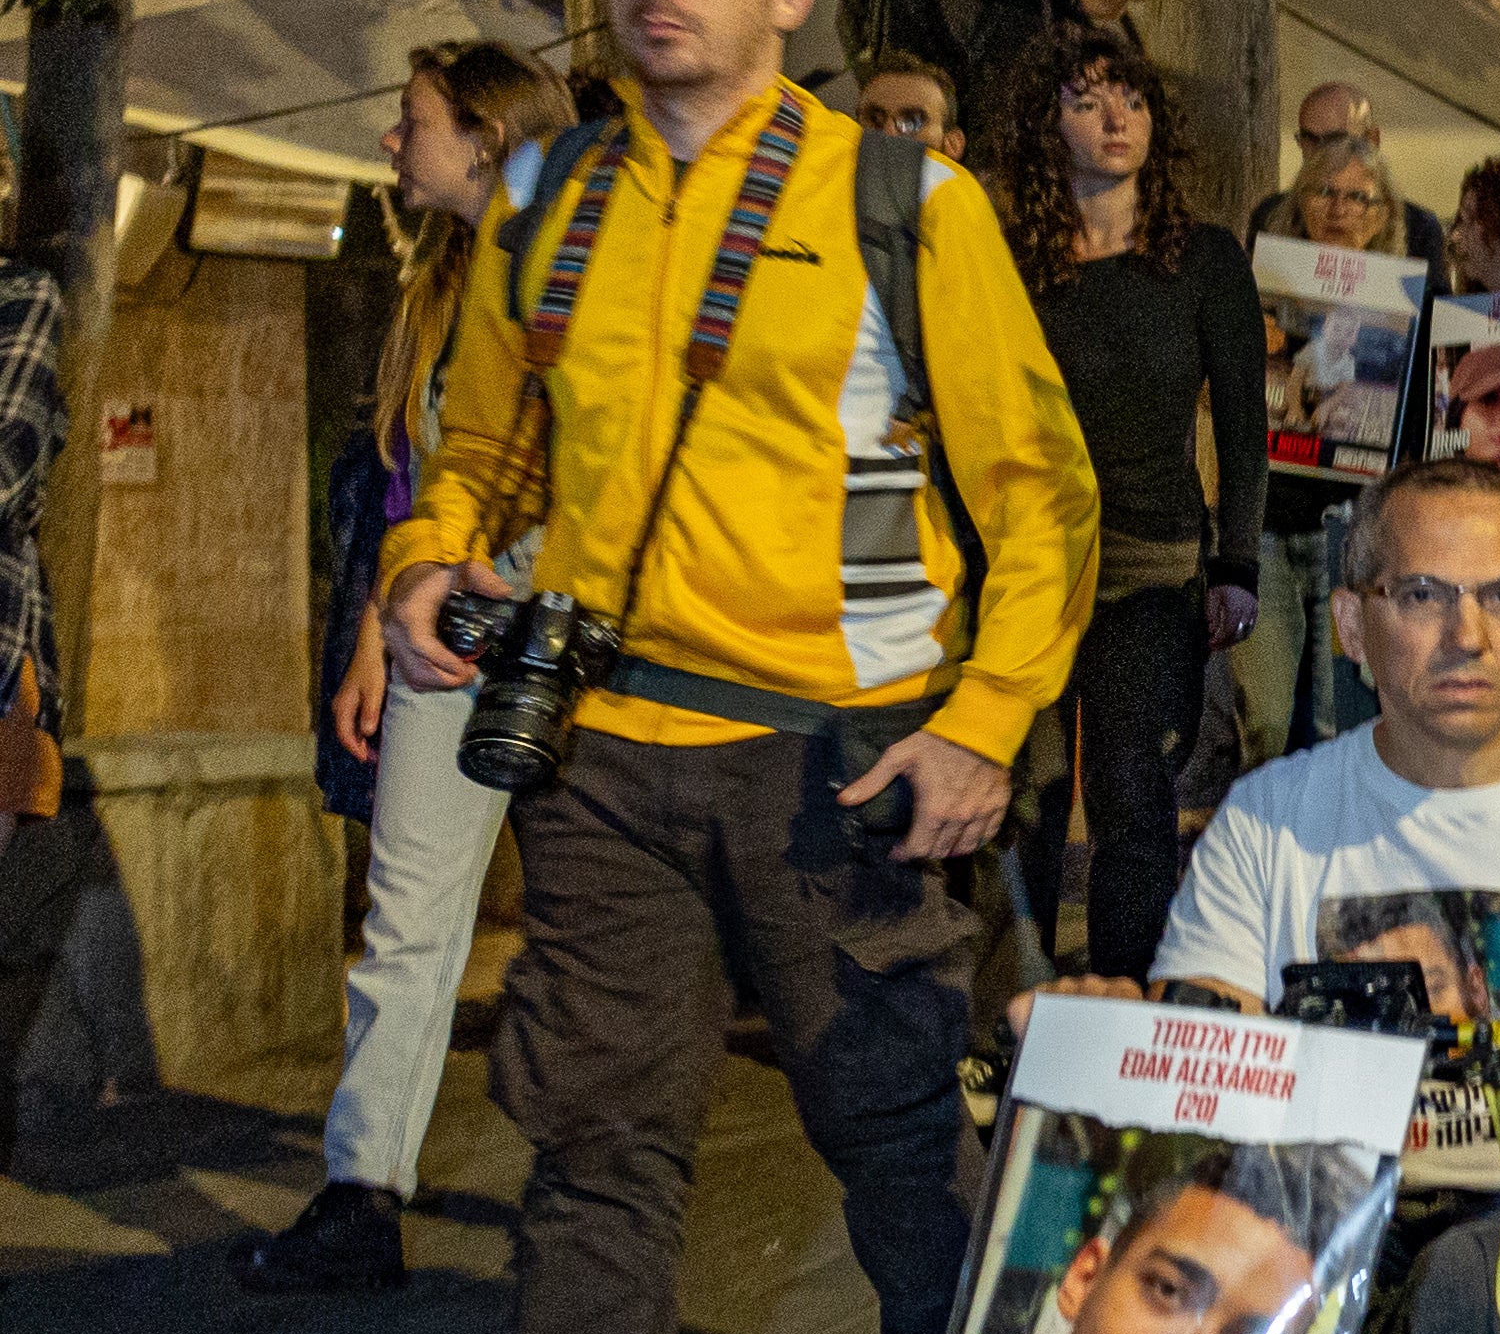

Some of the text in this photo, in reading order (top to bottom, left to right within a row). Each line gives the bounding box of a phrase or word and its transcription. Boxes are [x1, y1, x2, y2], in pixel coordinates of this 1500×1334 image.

[1240, 1029, 1287, 1063] עידן
[1119, 1047, 1296, 1102] EDAN ALEXANDER
[1175, 1088, 1219, 1127] (20)
